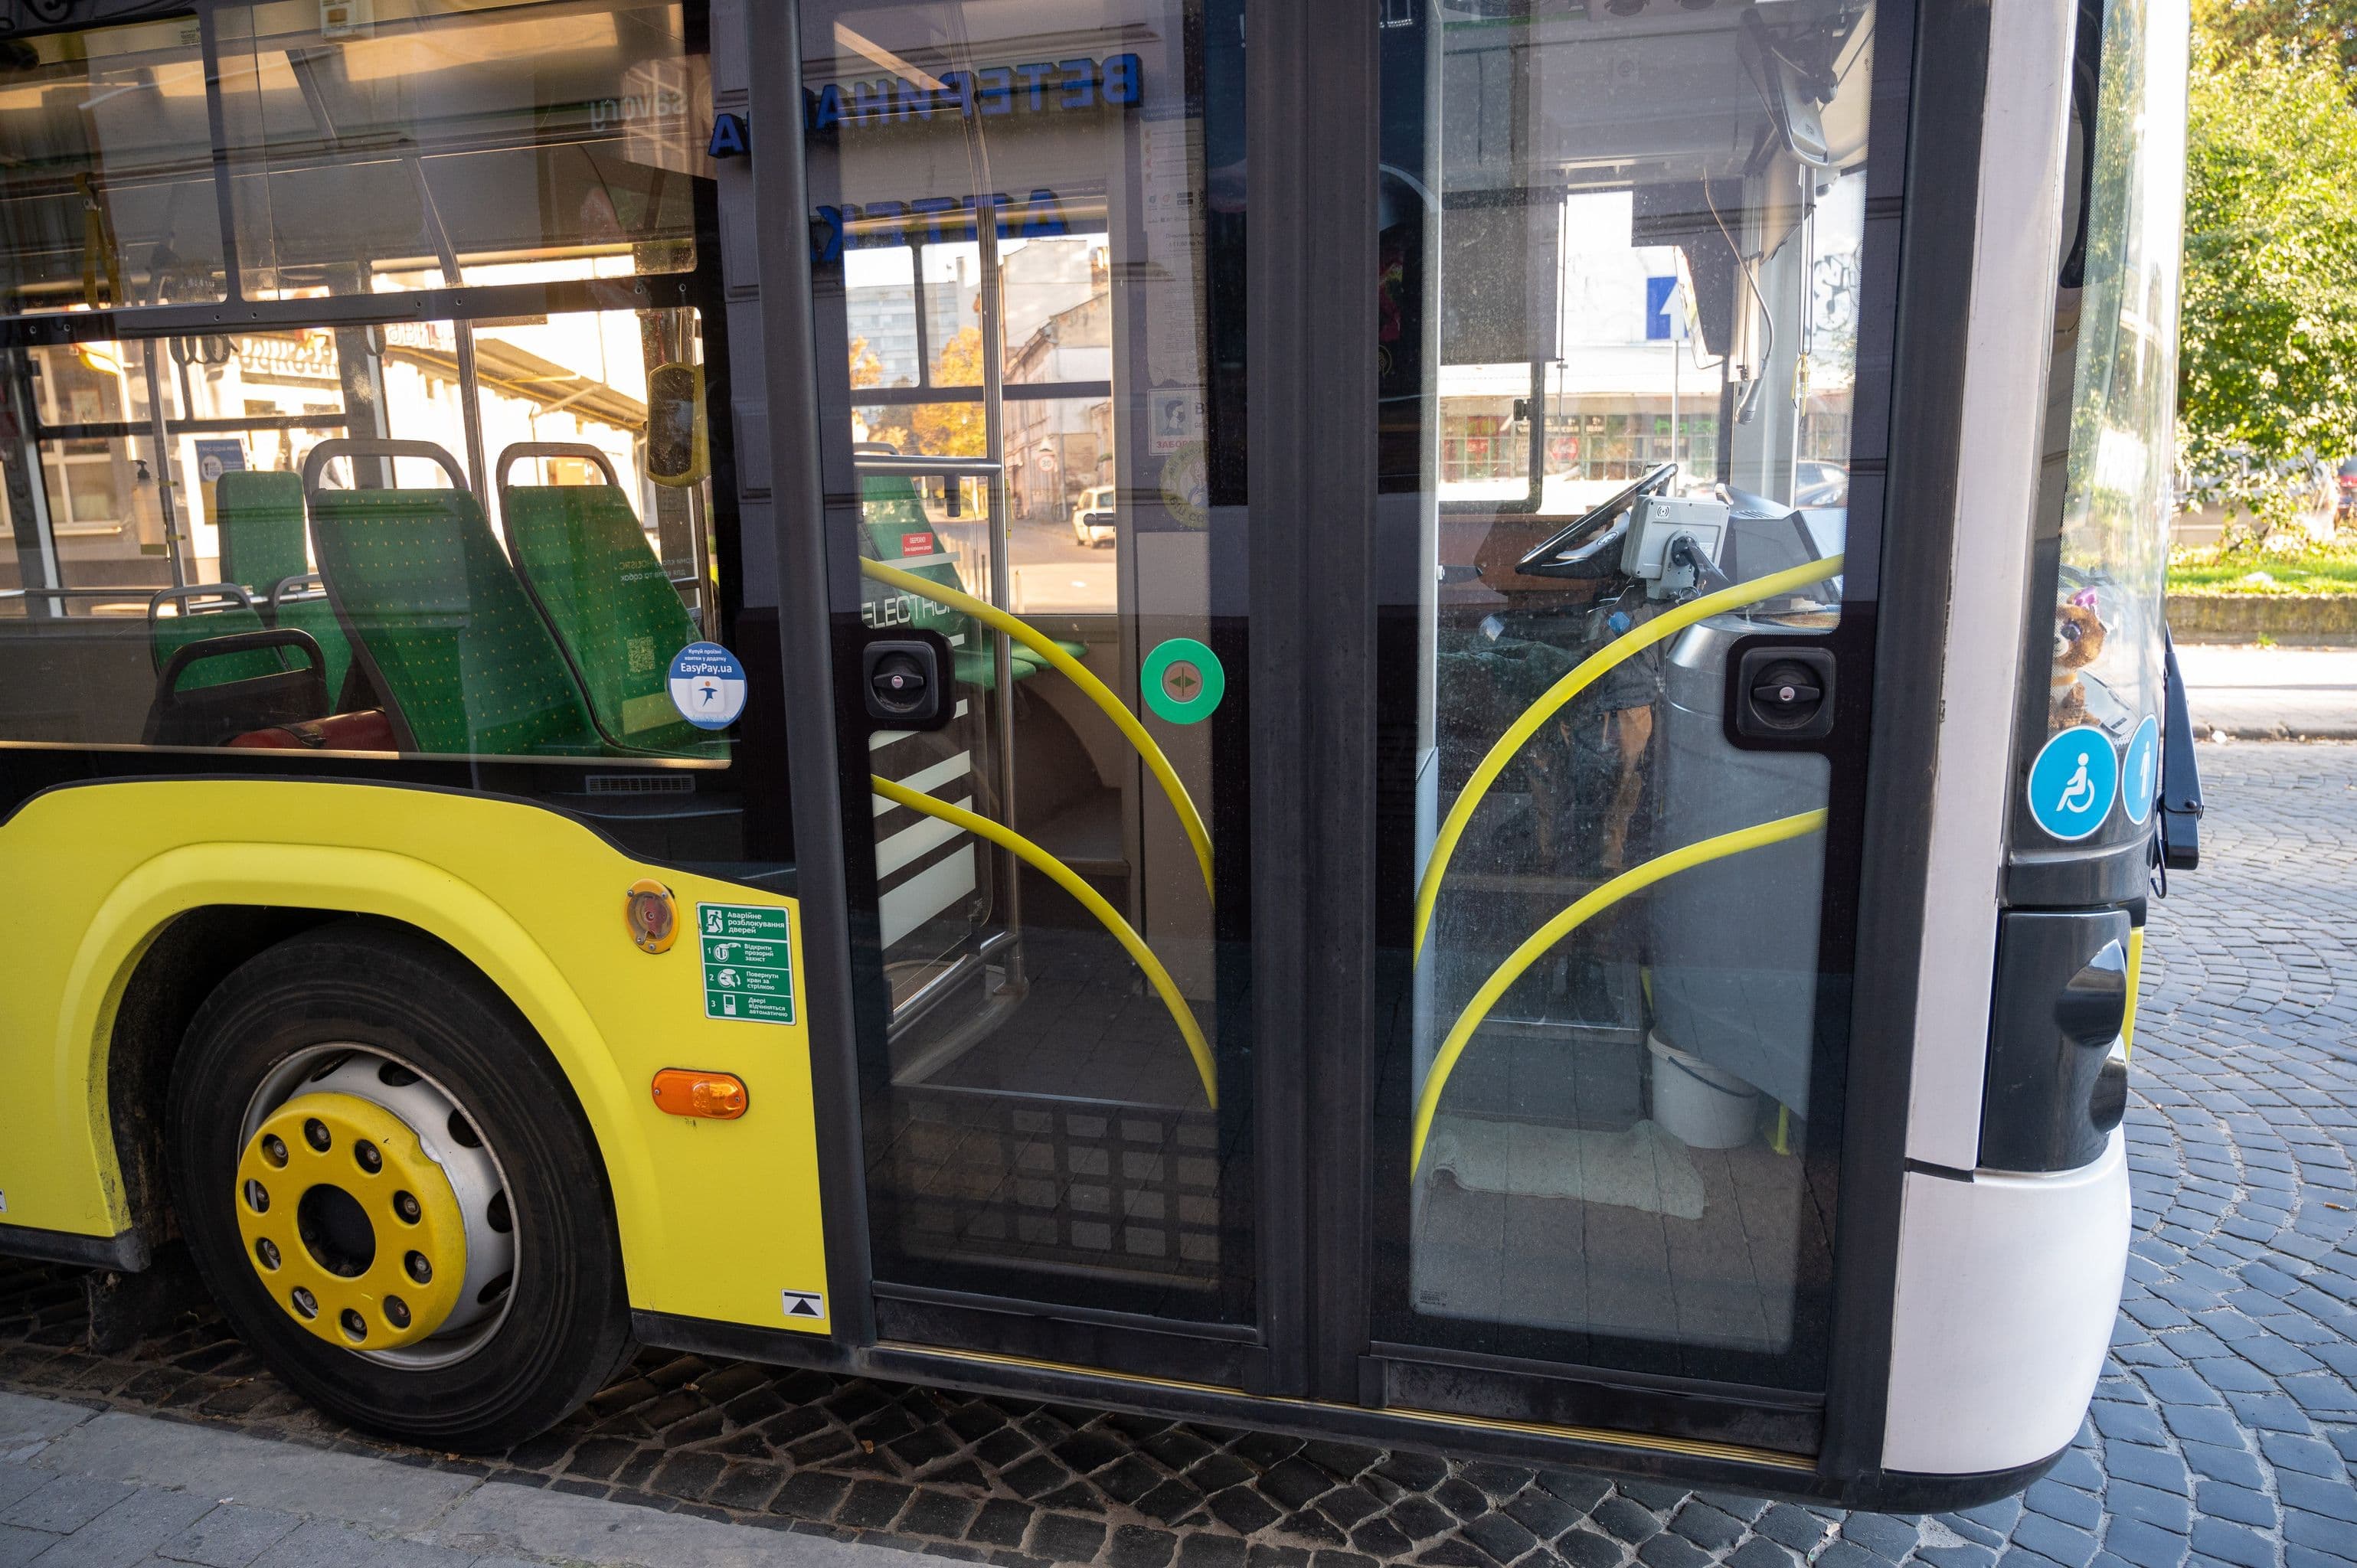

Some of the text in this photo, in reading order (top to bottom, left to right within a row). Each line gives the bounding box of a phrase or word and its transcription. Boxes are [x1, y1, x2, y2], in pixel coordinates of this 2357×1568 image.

[1041, 459, 1052, 468] 30
[681, 663, 733, 675] EasyPay.ua
[727, 911, 762, 920] Аварійне
[728, 920, 785, 929] розблокування
[746, 971, 779, 979] Повернути
